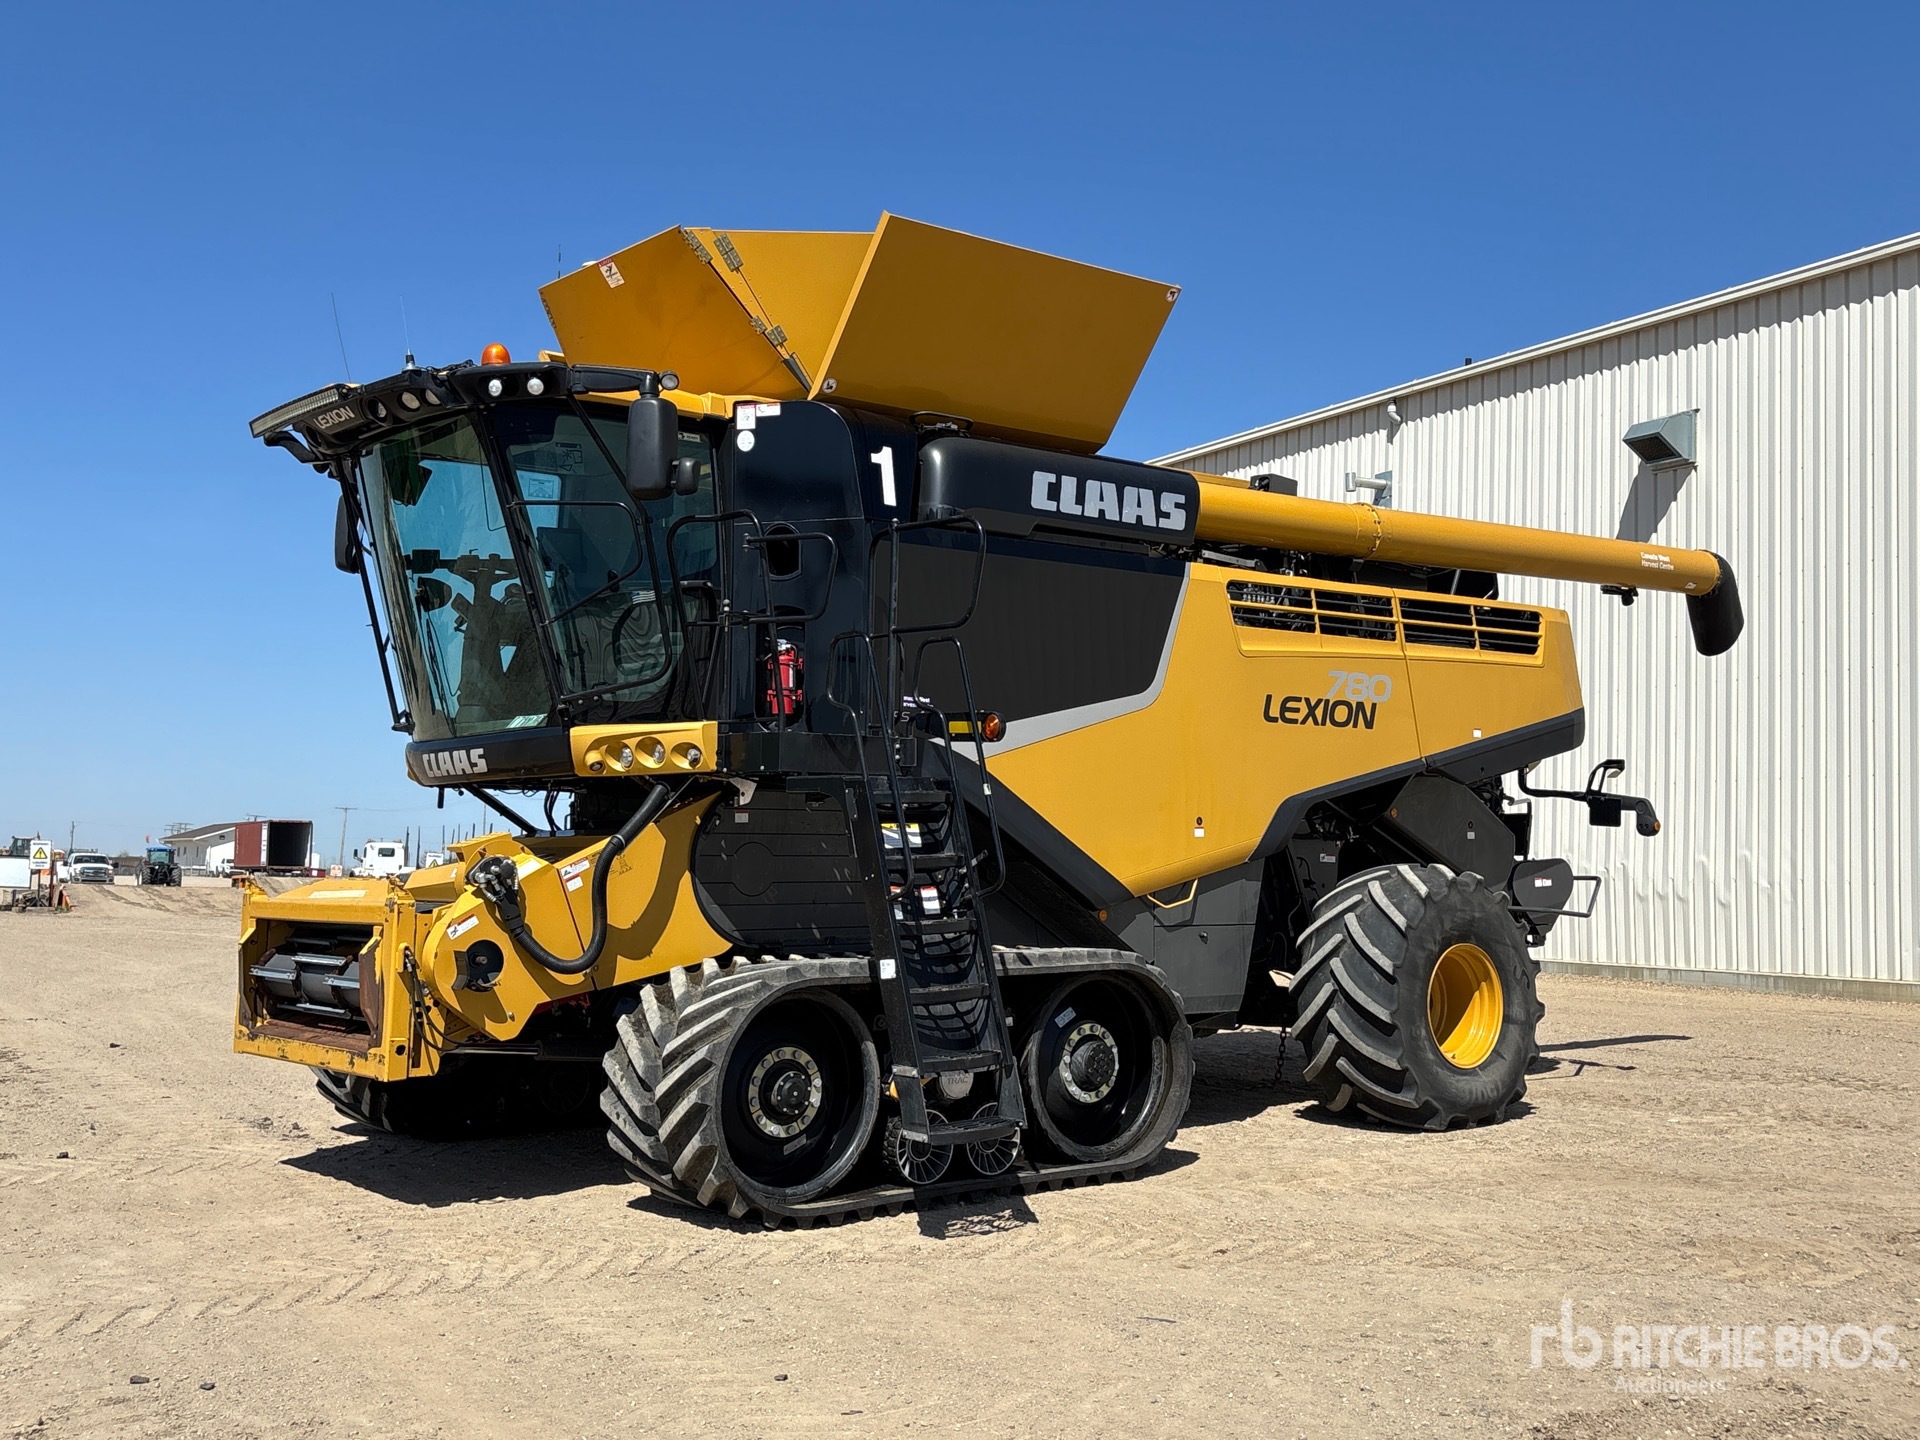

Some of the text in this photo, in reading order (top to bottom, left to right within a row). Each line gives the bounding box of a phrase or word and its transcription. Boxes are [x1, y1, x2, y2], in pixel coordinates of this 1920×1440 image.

[313, 405, 355, 429] LEXION
[871, 446, 896, 507] 1
[1031, 470, 1187, 531] CLAAS
[1641, 559, 1659, 568] Harvest
[1325, 670, 1392, 703] 780
[1263, 694, 1378, 730] LEXION
[422, 747, 488, 778] CLAAS
